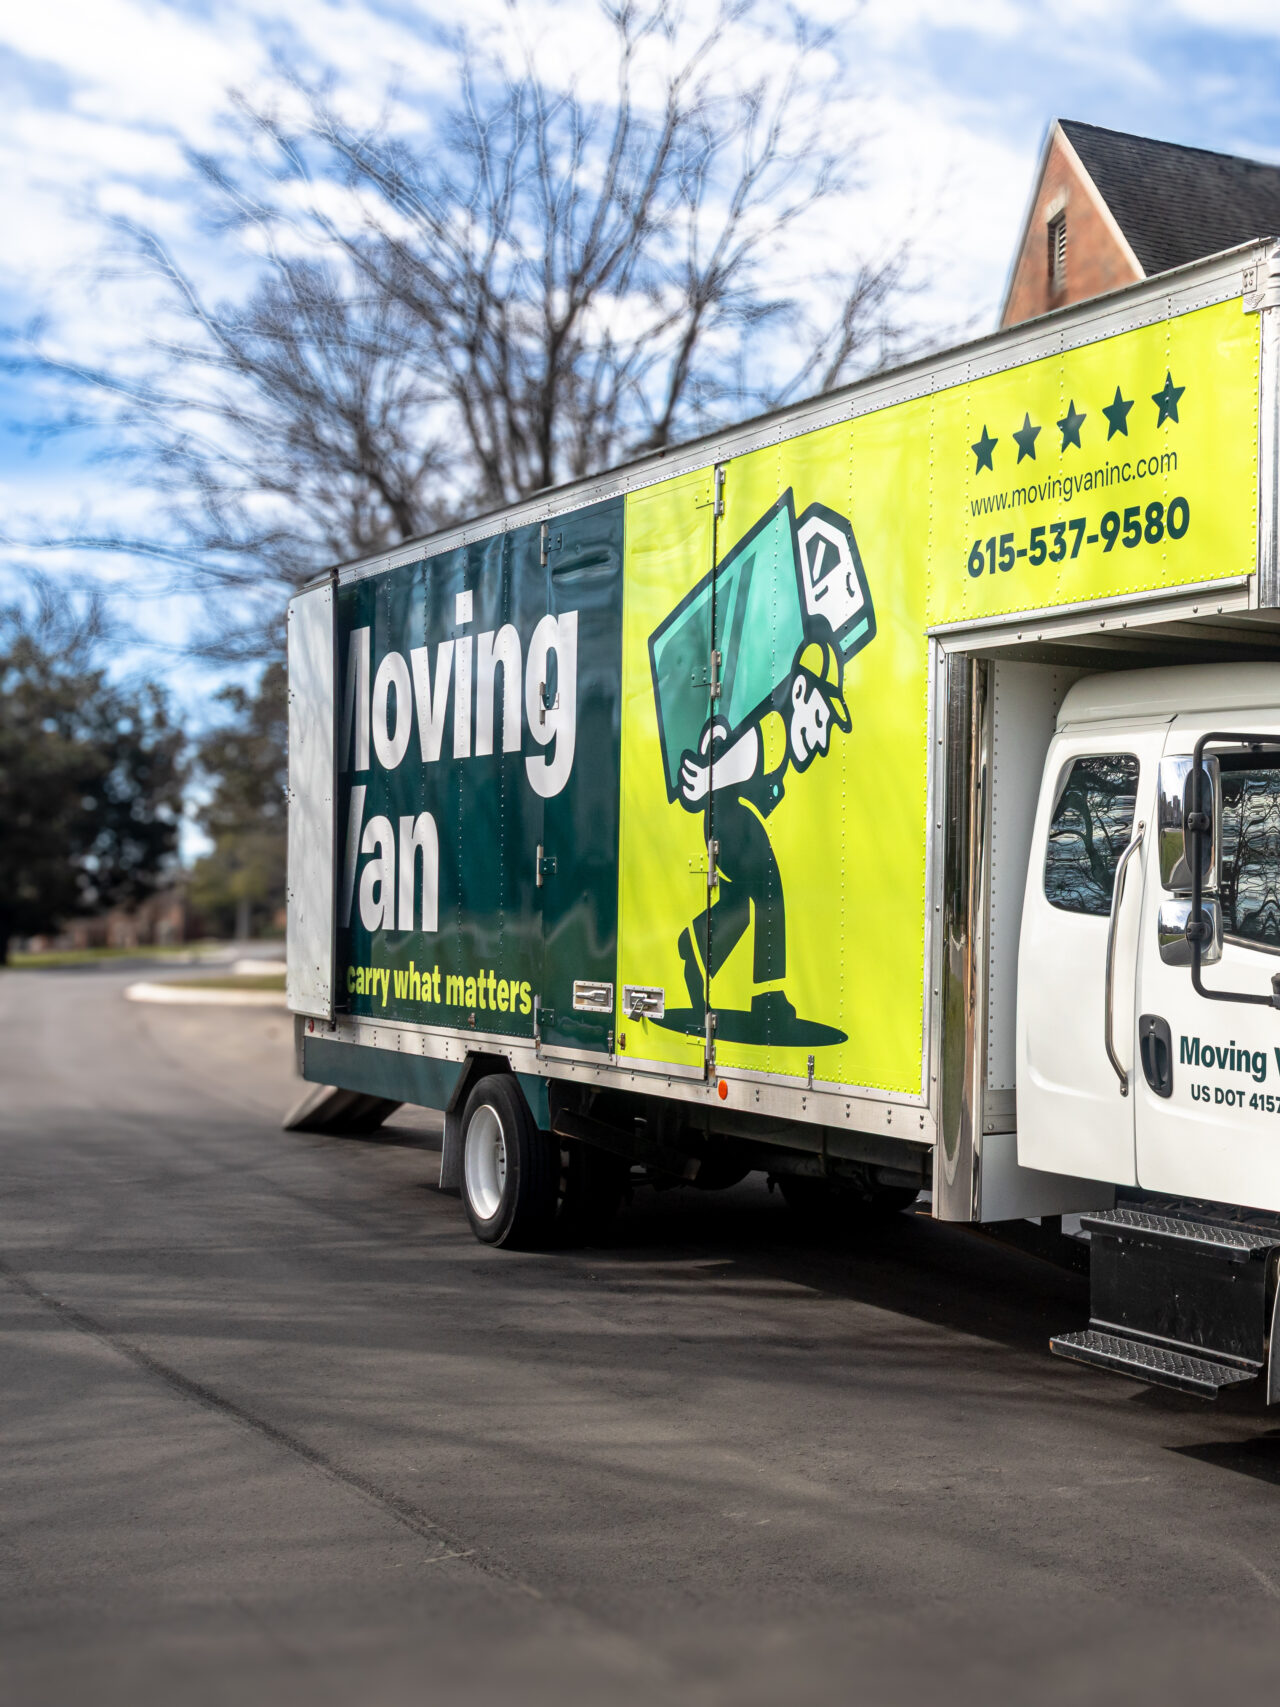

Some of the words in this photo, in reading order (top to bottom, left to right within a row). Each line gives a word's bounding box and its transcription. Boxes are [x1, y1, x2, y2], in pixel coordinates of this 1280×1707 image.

[970, 451, 1178, 517] www.movingvaninc.com
[967, 496, 1190, 578] 615-537-9580
[347, 965, 390, 1007] carry
[394, 961, 441, 1004] what
[446, 969, 532, 1015] matters
[1180, 1036, 1267, 1083] Moving
[1191, 1083, 1210, 1102] US
[1215, 1088, 1245, 1107] DOT
